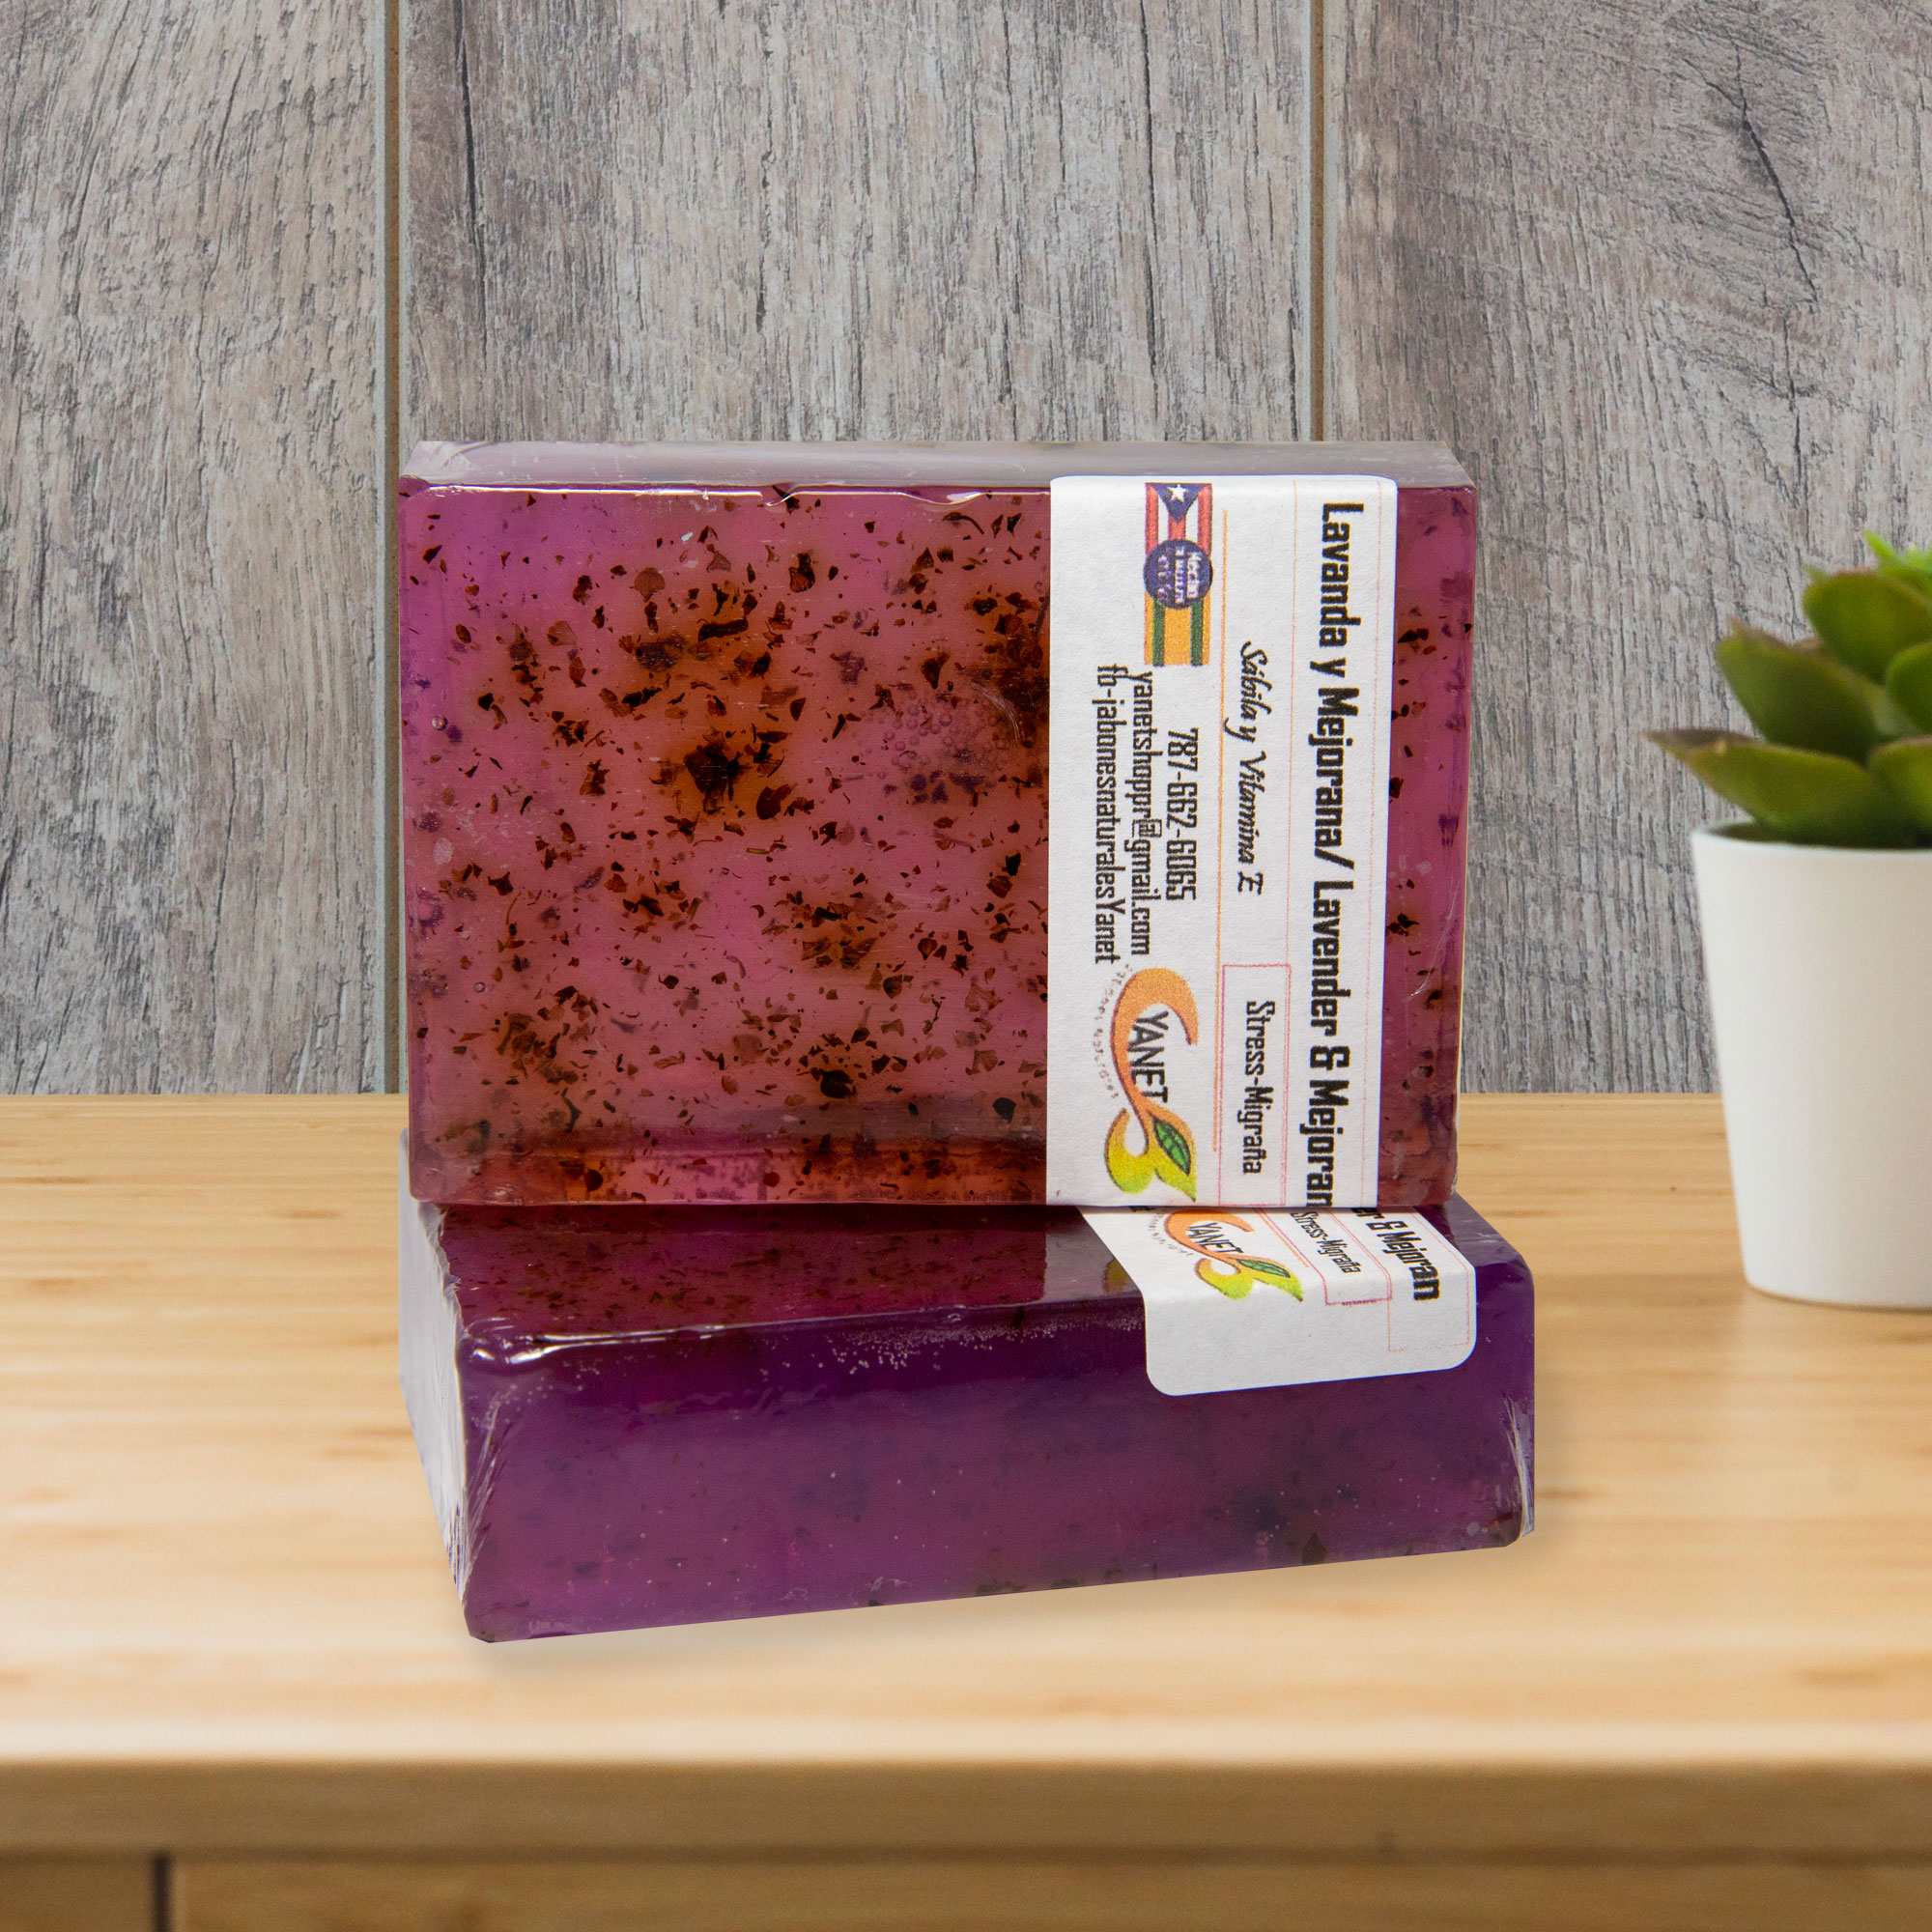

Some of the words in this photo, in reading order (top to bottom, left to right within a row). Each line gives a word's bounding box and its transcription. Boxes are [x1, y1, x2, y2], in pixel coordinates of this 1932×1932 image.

[1319, 501, 1364, 647] Lavanda
[1240, 640, 1272, 722] Sábila
[1310, 658, 1347, 678] y
[1224, 718, 1257, 743] y
[1308, 687, 1360, 870] Mejorana/
[1092, 663, 1128, 964] fb-jabonesnaturalesYanet
[1123, 670, 1163, 955] yanetshoppr@gmail.com
[1165, 727, 1199, 901] 787-662-6065
[1237, 751, 1266, 865] Vitamina
[1237, 871, 1264, 895] E
[1311, 880, 1354, 1037] Lavender
[1126, 1010, 1170, 1103] YANET
[1237, 1000, 1275, 1176] Stress-Migraña
[1309, 1045, 1350, 1071] &
[1185, 1222, 1244, 1255] YANET
[1377, 1231, 1440, 1301] Mejoran
